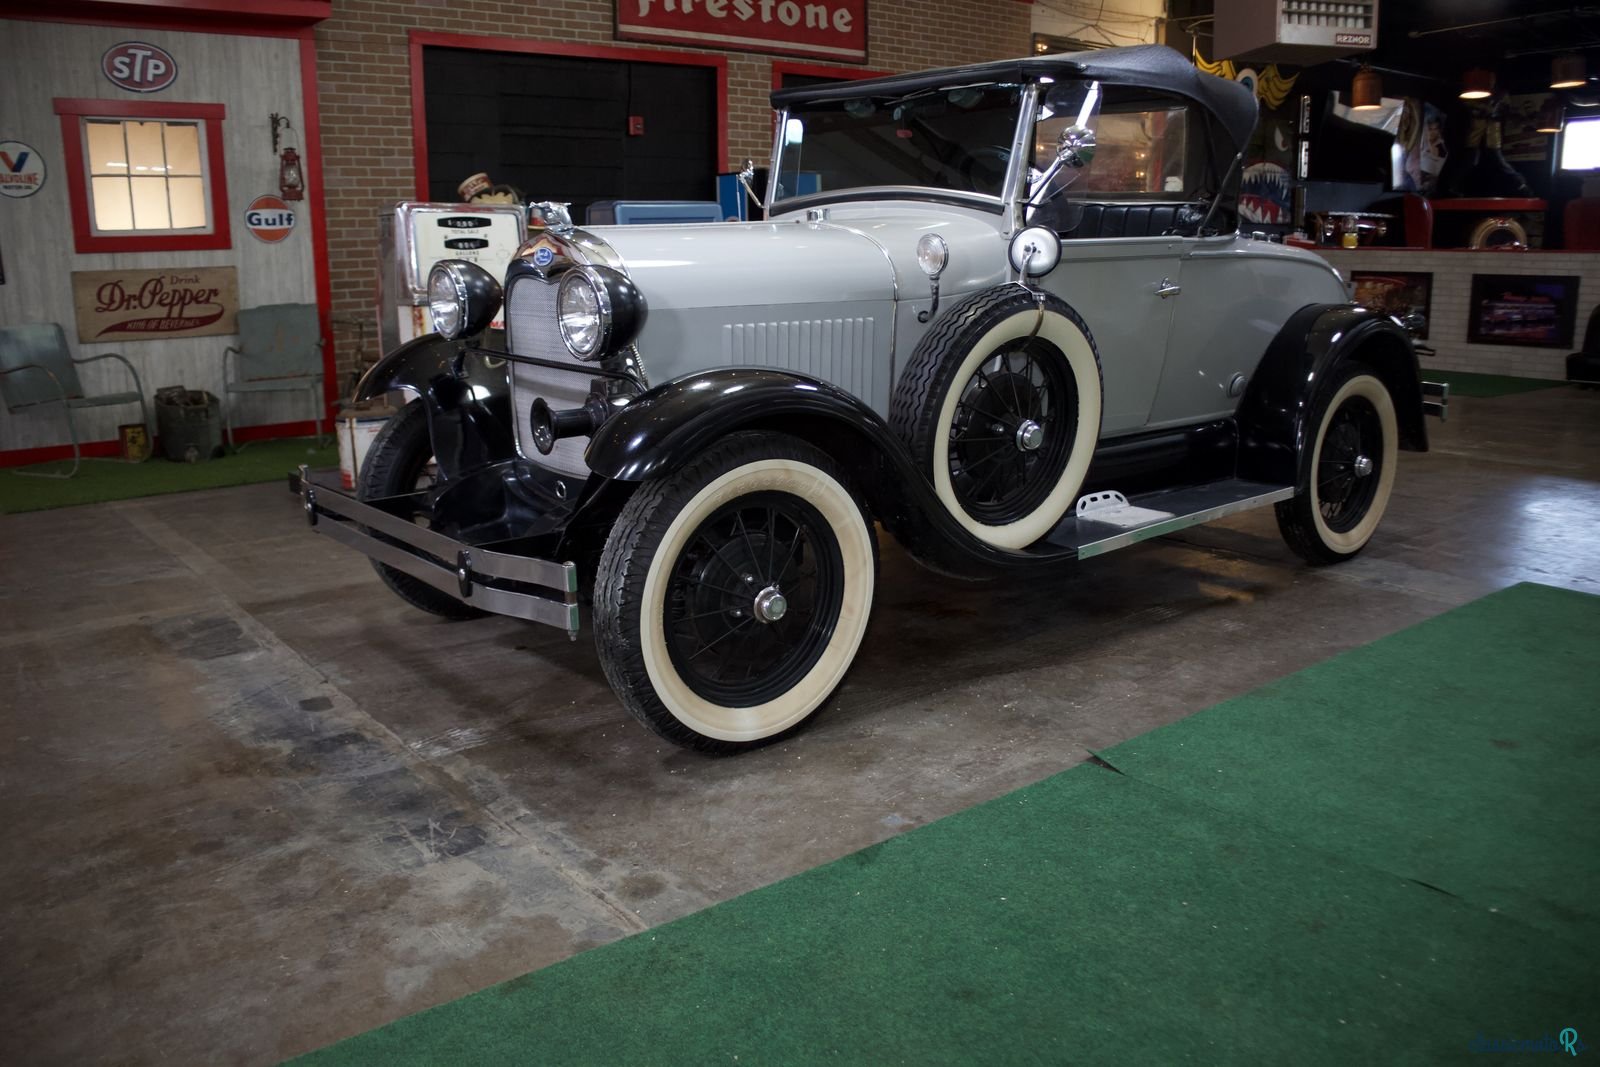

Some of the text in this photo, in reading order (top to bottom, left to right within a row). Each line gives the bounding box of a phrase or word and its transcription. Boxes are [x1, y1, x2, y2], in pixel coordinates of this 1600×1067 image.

[112, 48, 166, 82] STP
[247, 212, 294, 226] Gulf
[170, 275, 201, 285] Drink
[126, 320, 146, 329] KING
[147, 319, 159, 329] OF
